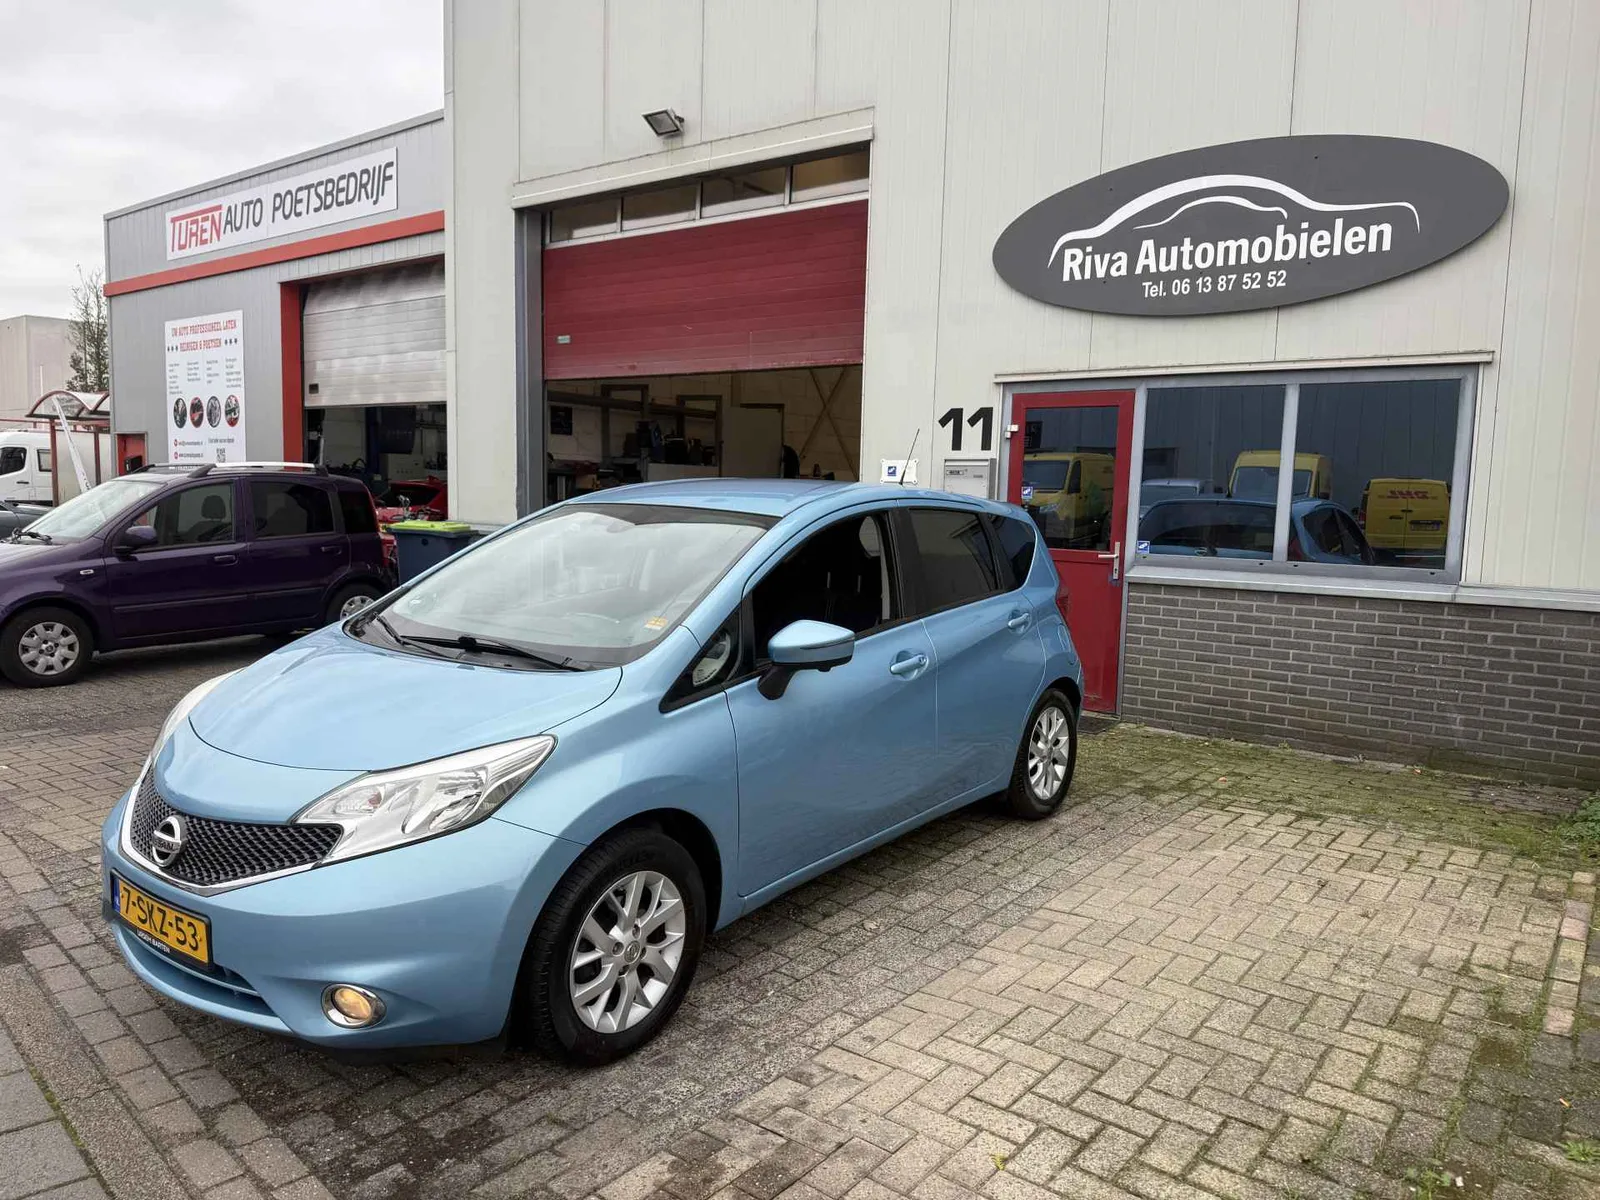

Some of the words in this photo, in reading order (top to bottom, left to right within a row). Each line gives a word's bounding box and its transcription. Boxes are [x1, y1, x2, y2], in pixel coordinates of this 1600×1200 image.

[171, 204, 222, 251] TUREN
[223, 197, 262, 234] AUTO
[272, 161, 394, 223] POETSBEDRIJF
[1062, 246, 1128, 282] Riva
[1134, 218, 1392, 275] Automobielen
[1142, 279, 1167, 299] Tel.
[1172, 277, 1191, 296] 06
[1196, 275, 1213, 294] 13
[1217, 273, 1237, 293] 87
[1242, 271, 1262, 290] 52
[1267, 269, 1287, 288] 52
[938, 407, 993, 450] 11
[122, 887, 199, 951] 7-SKZ-53
